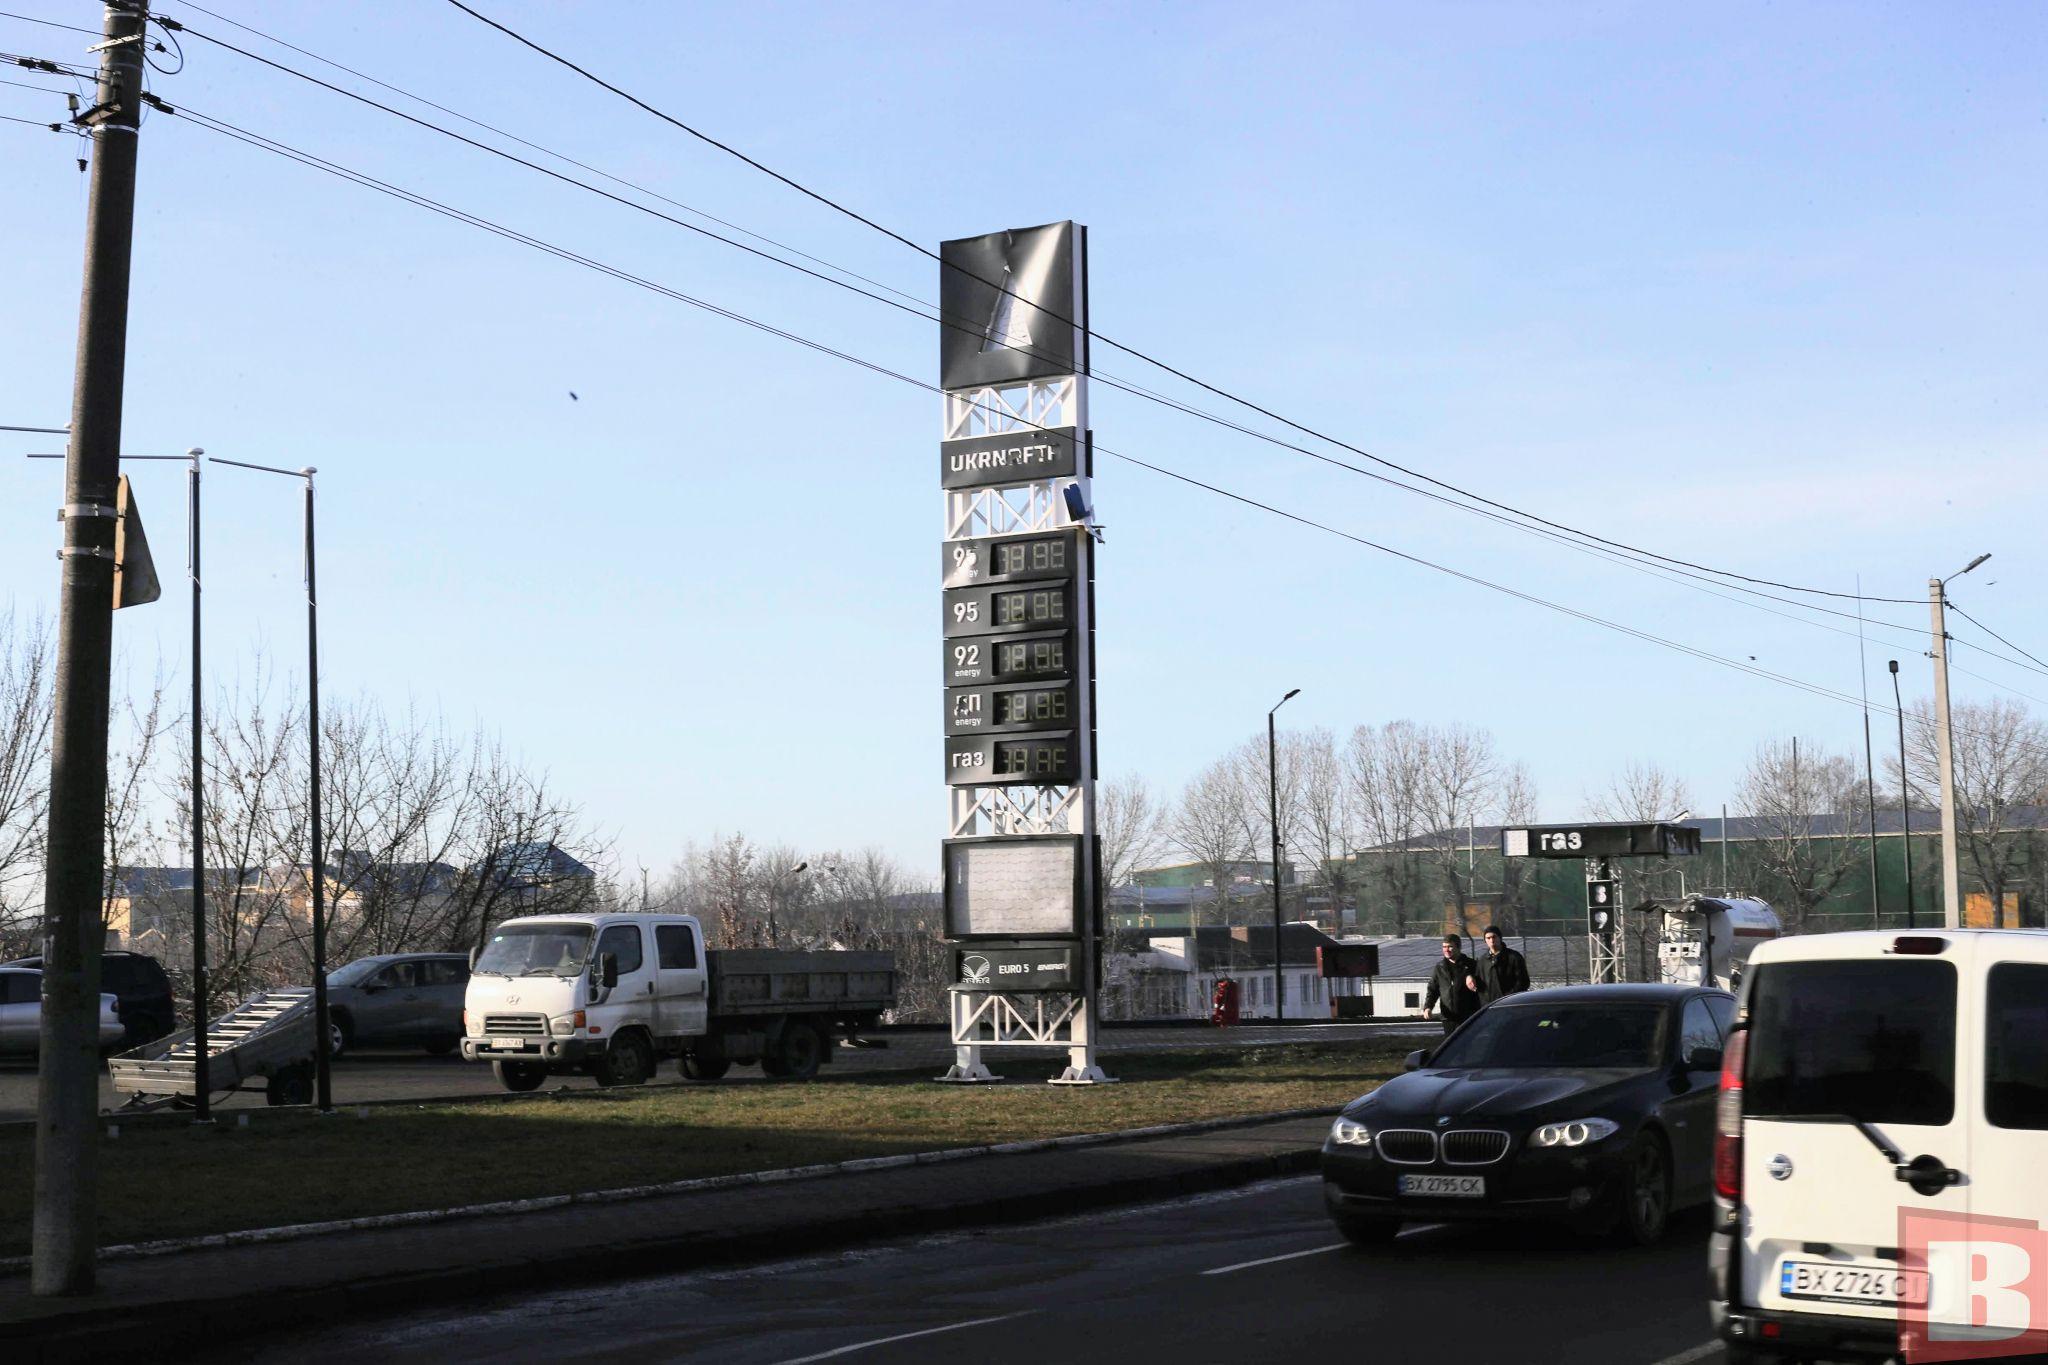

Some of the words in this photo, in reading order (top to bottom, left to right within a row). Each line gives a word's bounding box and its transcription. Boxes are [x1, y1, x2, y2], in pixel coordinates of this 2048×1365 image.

[954, 601, 979, 622] 95
[954, 645, 979, 666] 92
[954, 668, 981, 677] energy
[955, 718, 982, 727] energy
[998, 964, 1022, 975] EURO
[1023, 963, 1030, 973] 5
[1797, 1268, 1827, 1290] BX
[1833, 1271, 1885, 1295] 2726
